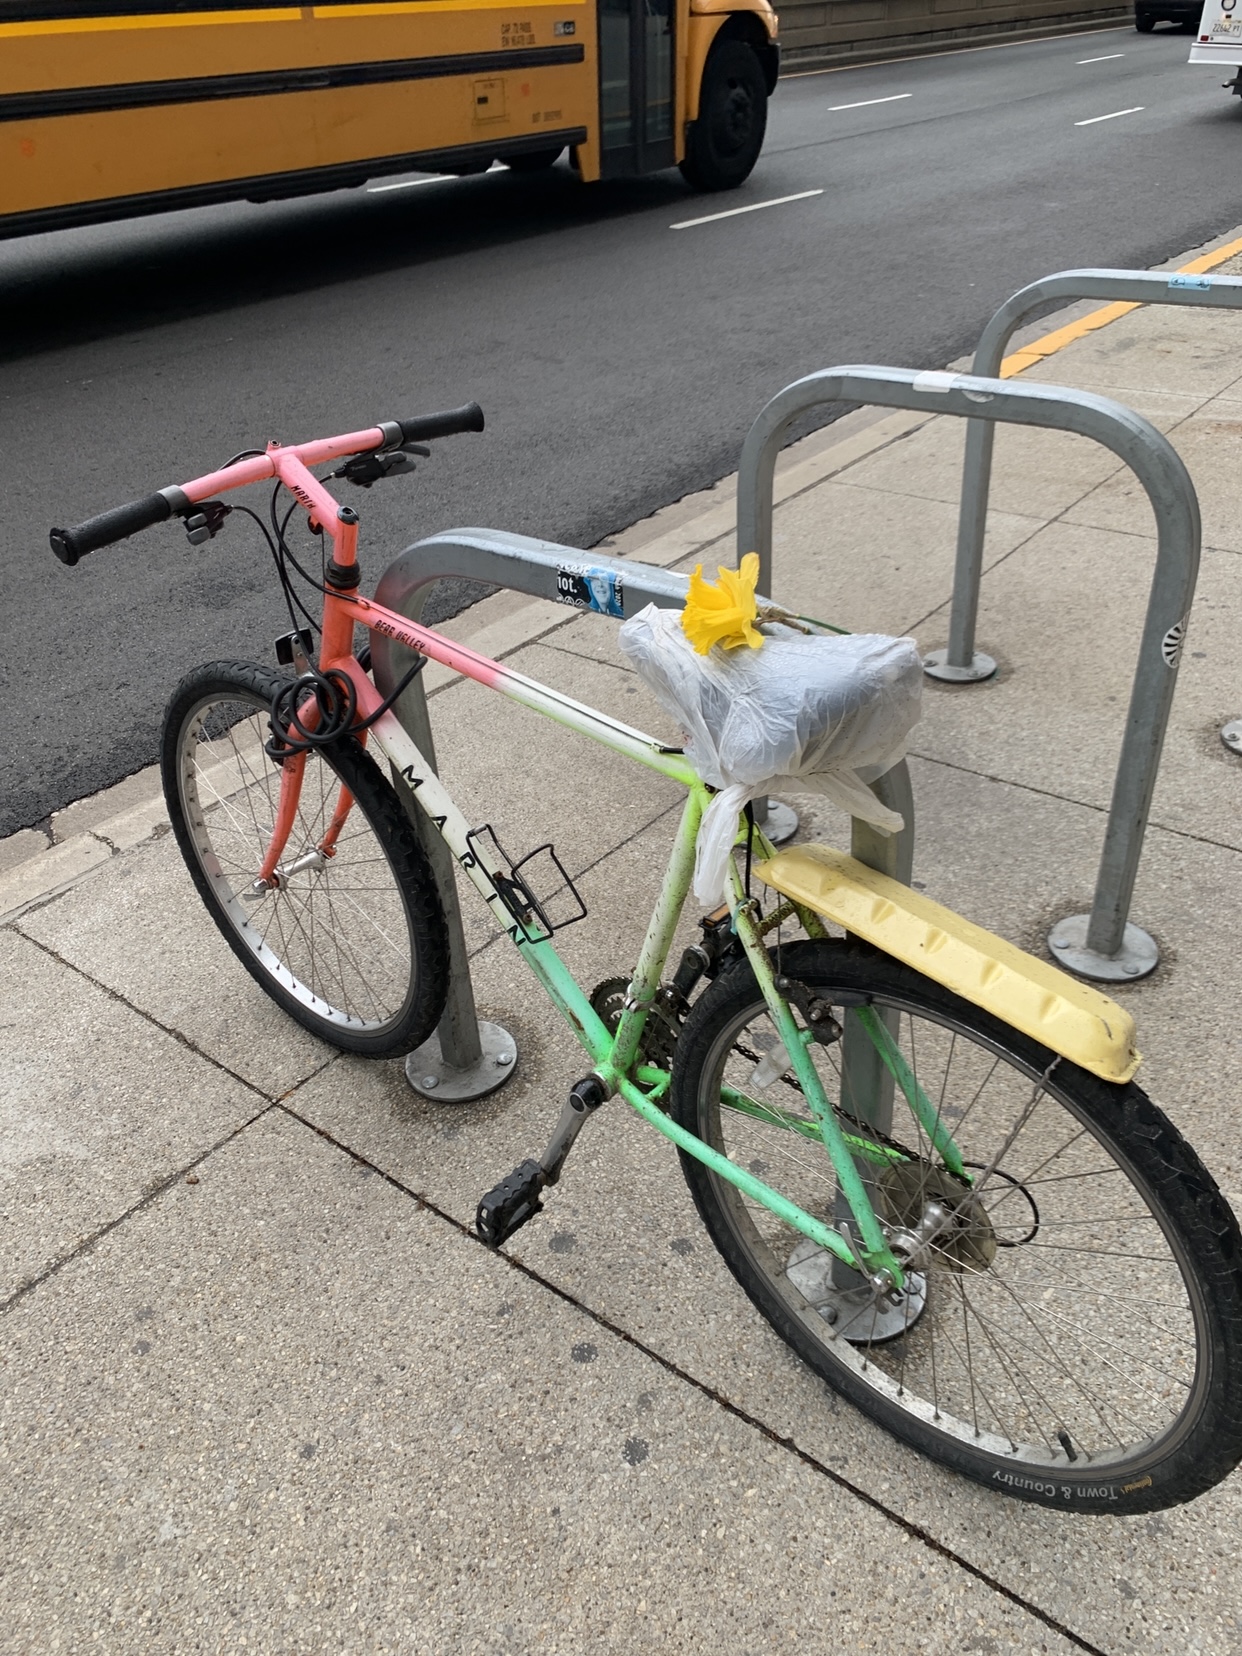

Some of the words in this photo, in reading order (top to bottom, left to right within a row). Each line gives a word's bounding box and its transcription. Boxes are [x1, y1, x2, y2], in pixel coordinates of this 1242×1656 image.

[400, 764, 527, 947] MARIN
[992, 1470, 1056, 1498] Country
[1061, 1486, 1072, 1500] &
[1077, 1486, 1119, 1500] Town
